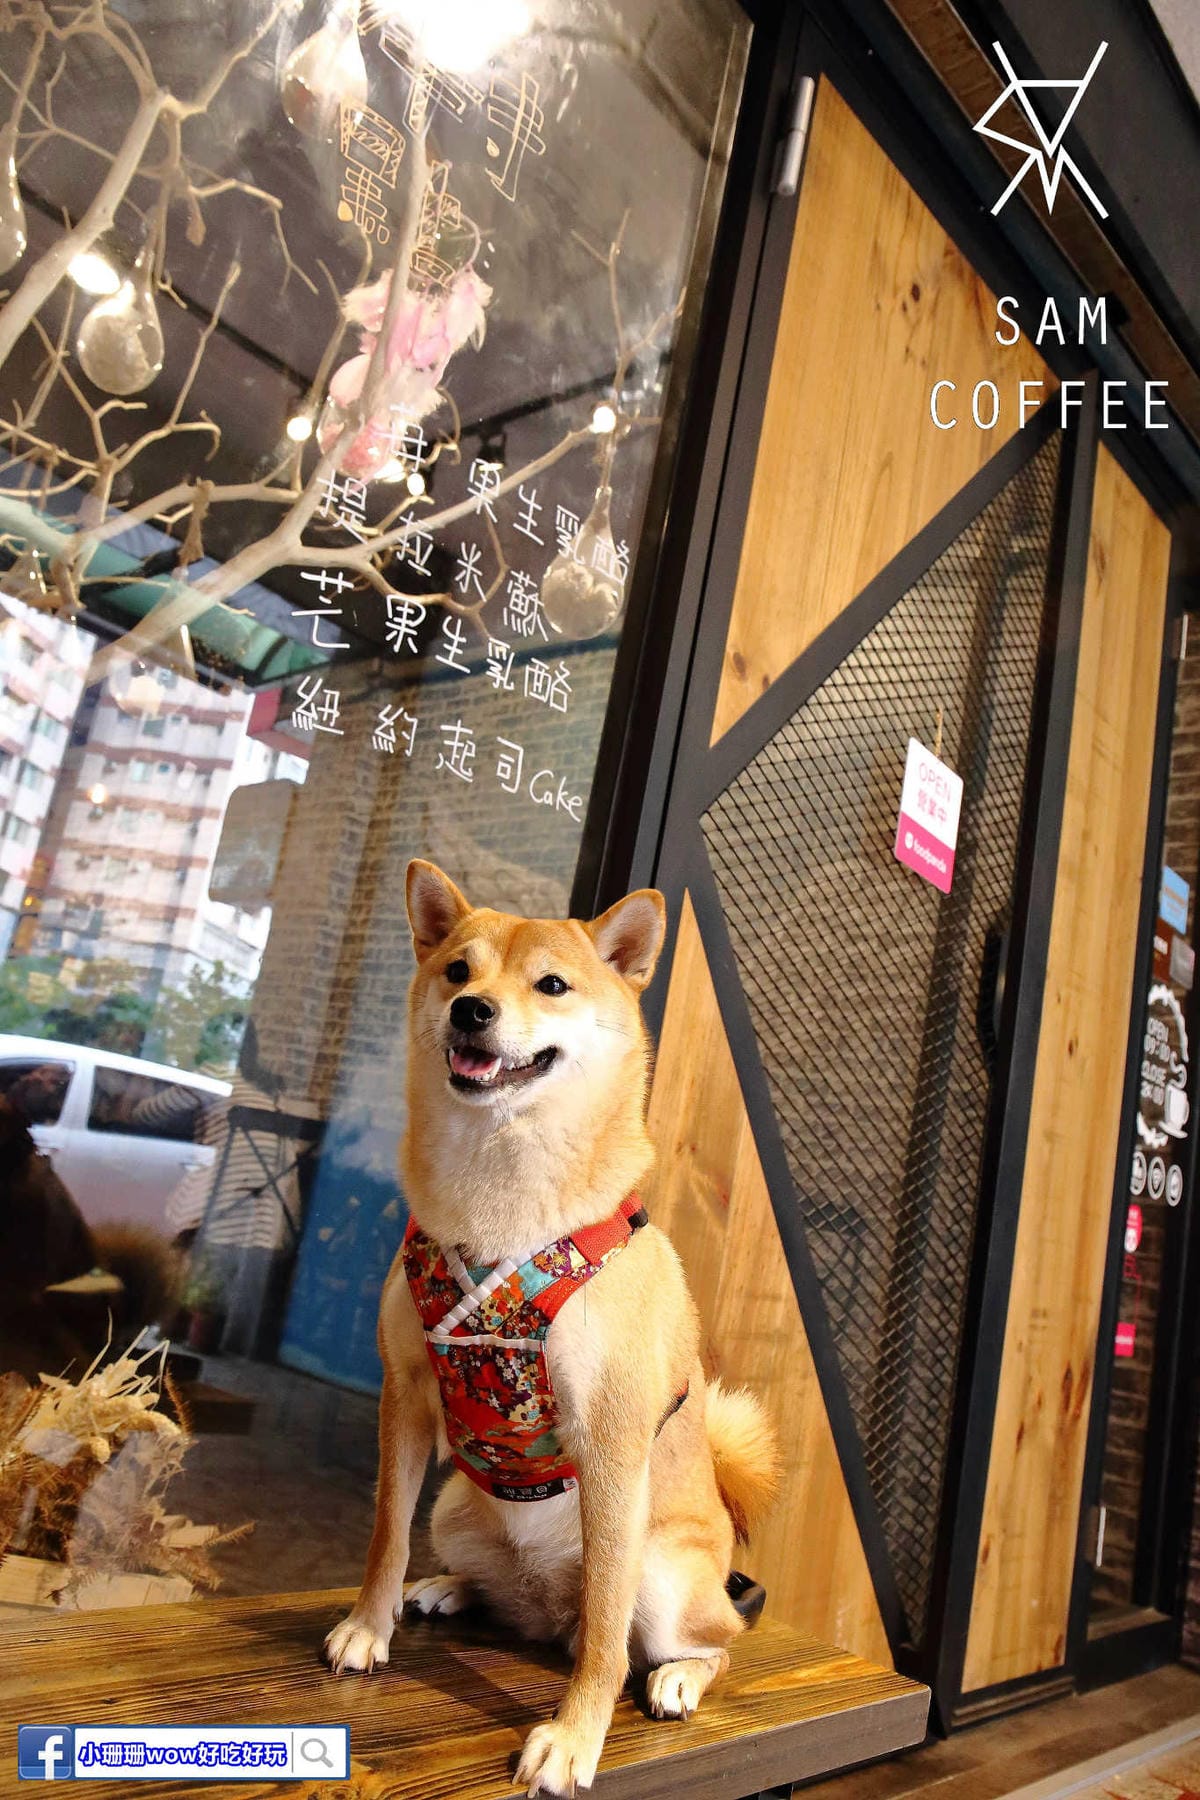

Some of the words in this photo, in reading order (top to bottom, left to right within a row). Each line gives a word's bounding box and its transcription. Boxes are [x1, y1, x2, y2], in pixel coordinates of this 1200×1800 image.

[291, 569, 573, 713] 芒果生乳酪
[918, 762, 951, 803] OPEN
